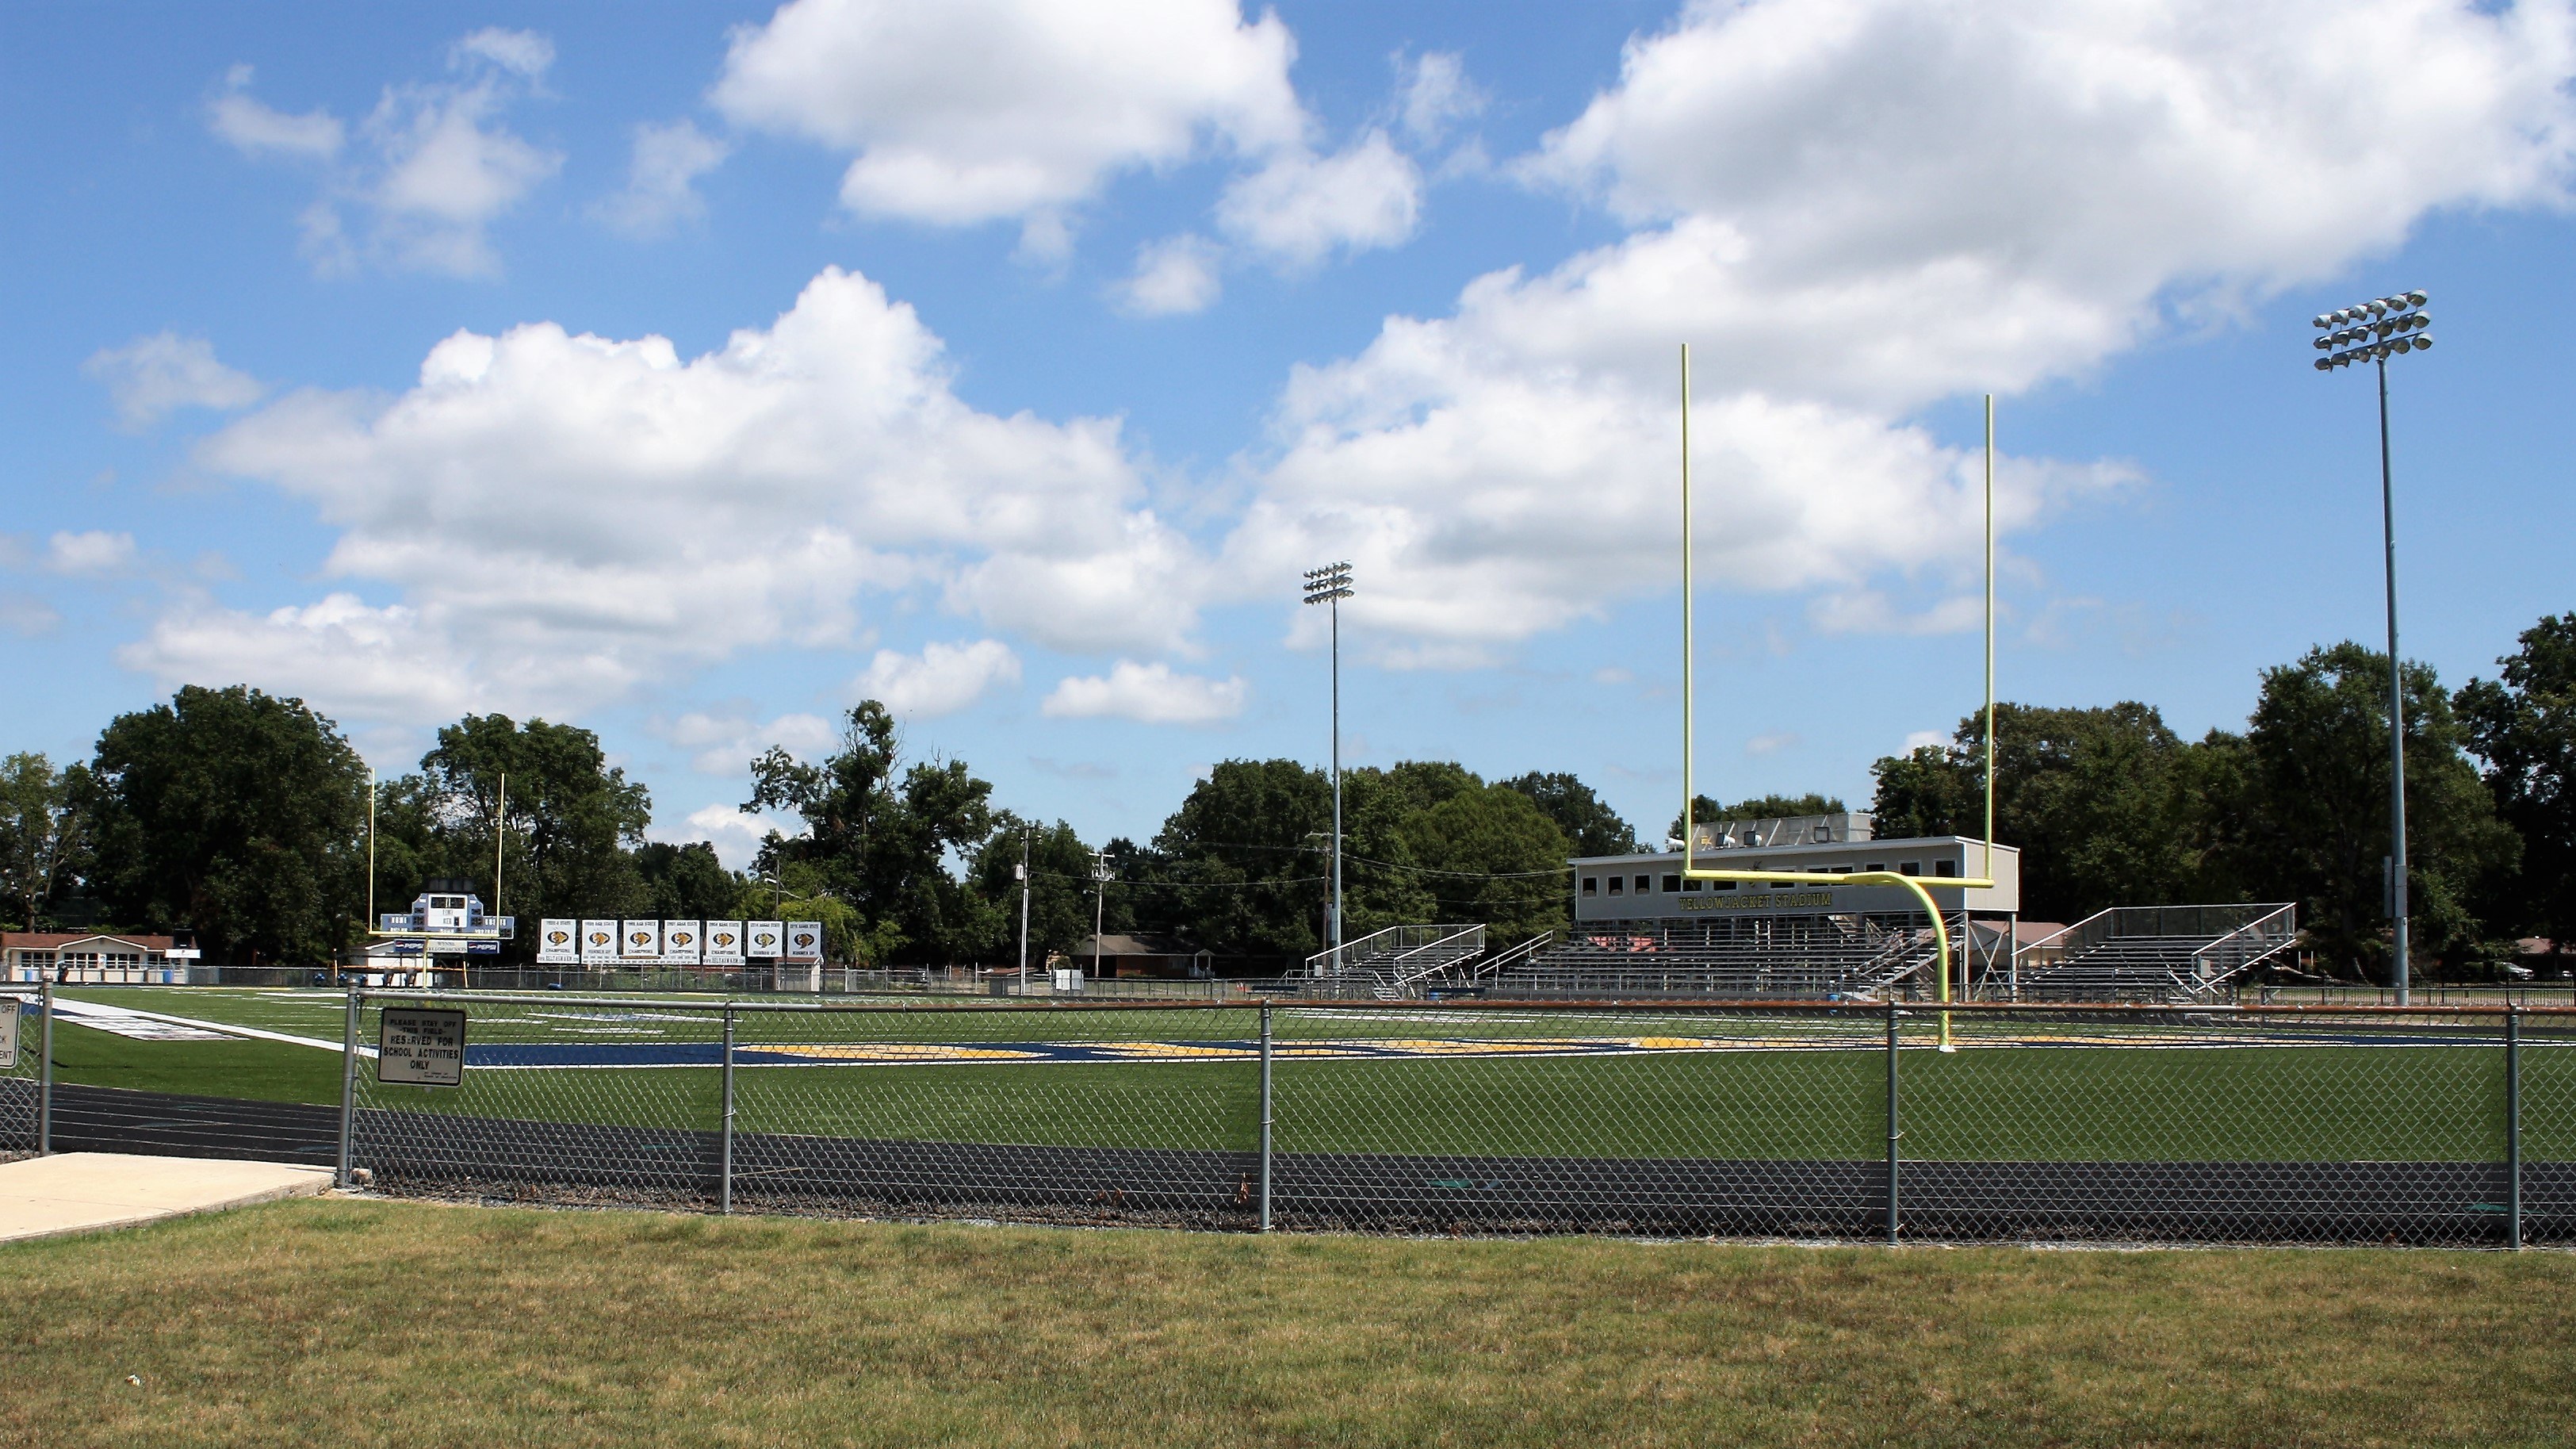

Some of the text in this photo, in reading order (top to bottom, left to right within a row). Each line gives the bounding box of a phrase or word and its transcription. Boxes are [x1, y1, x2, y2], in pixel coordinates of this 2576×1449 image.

[1678, 892, 1832, 910] YELLOWJACKET STADIUM
[2, 1005, 17, 1014] OFF
[438, 1037, 454, 1046] FOR
[383, 1047, 459, 1060] SCHOOL ACTIVITIES
[410, 1060, 430, 1071] ONLY
